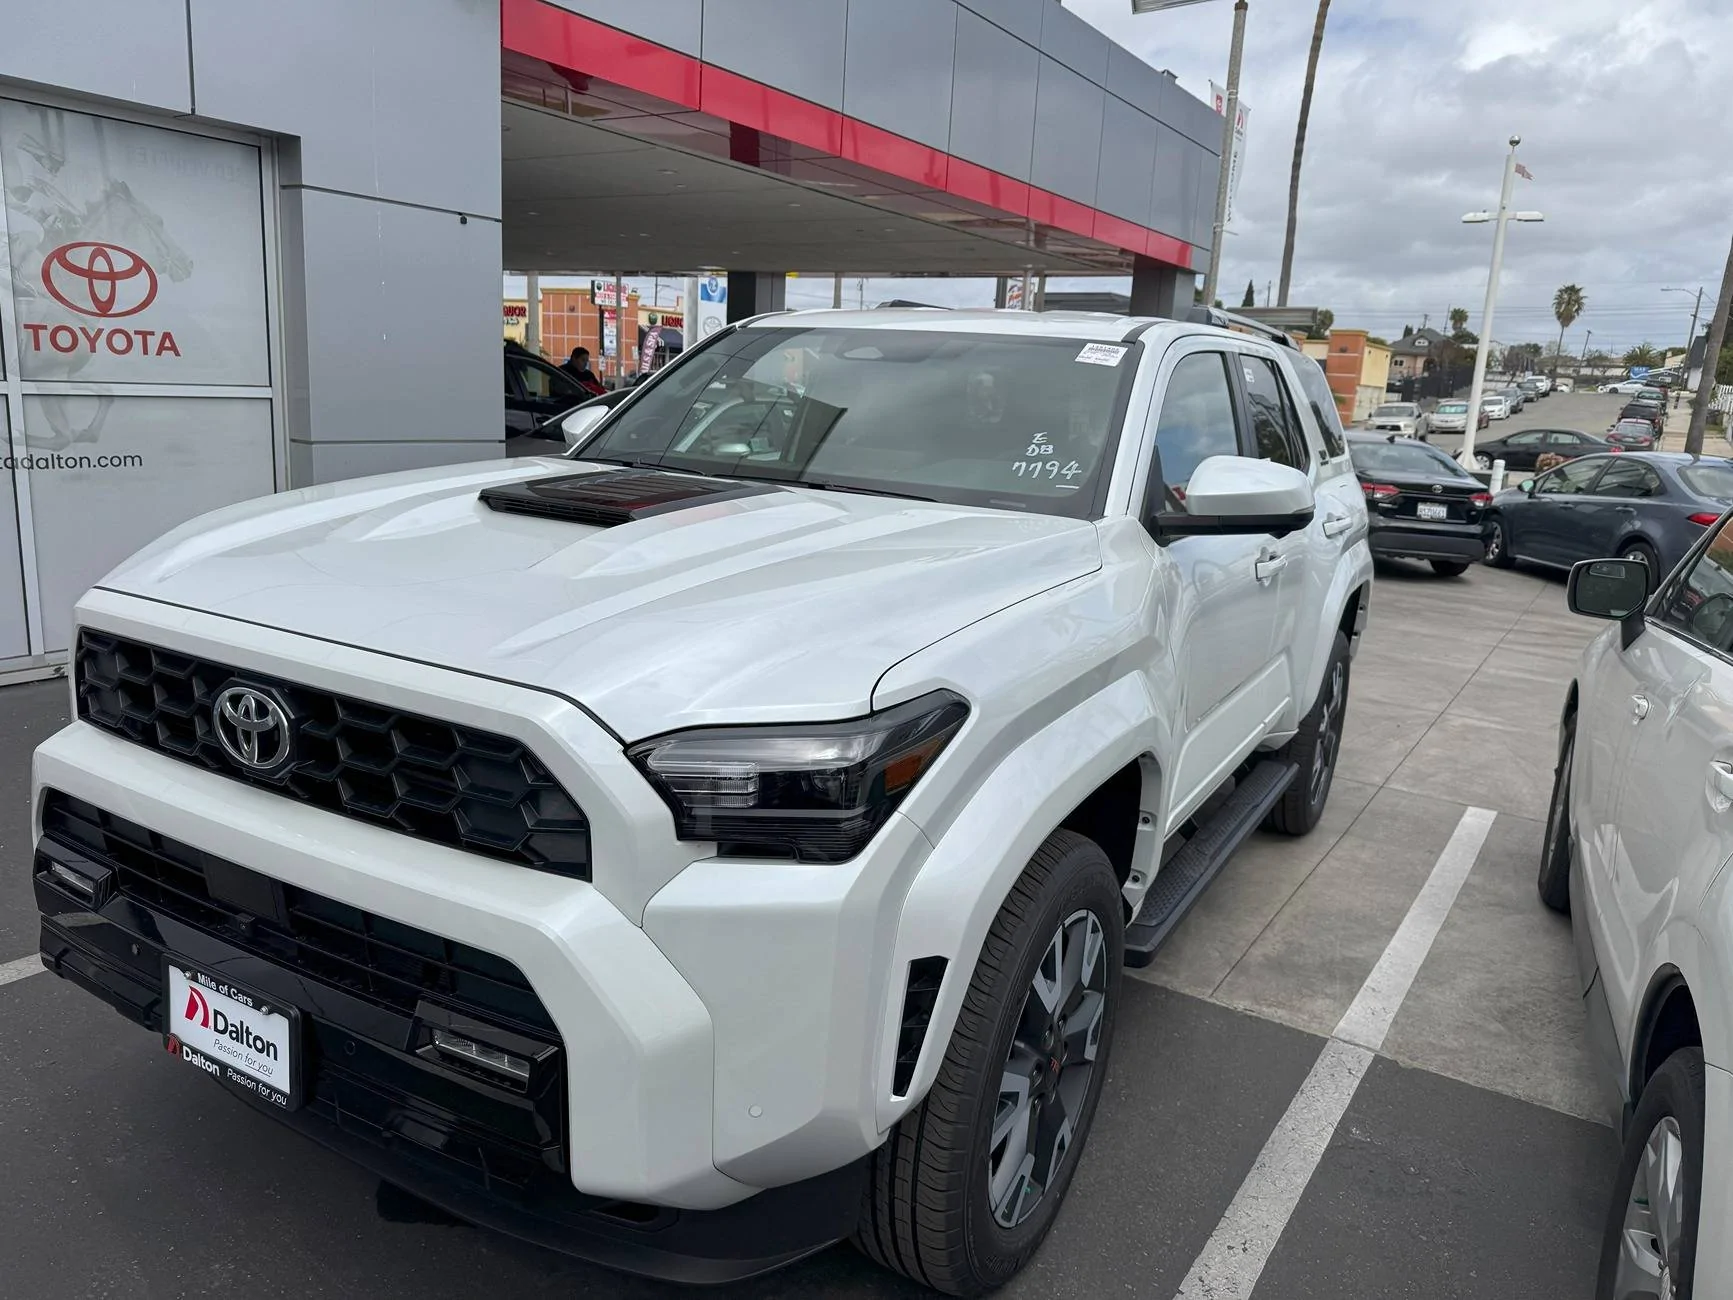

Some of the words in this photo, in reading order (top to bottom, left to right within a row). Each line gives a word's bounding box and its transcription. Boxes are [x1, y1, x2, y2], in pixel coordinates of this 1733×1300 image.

[503, 305, 527, 317] QUOR
[23, 323, 182, 357] TOYOTA
[1011, 460, 1082, 480] 7794
[197, 972, 217, 991] Mile
[219, 984, 230, 995] of
[230, 988, 253, 1006] Cars
[213, 1008, 279, 1062] Dalton
[213, 1038, 244, 1061] Passion
[244, 1051, 258, 1067] for
[258, 1061, 274, 1076] you
[182, 1046, 220, 1077] Dalton
[226, 1068, 257, 1091] Passion
[258, 1082, 271, 1097] for
[271, 1091, 288, 1106] you
